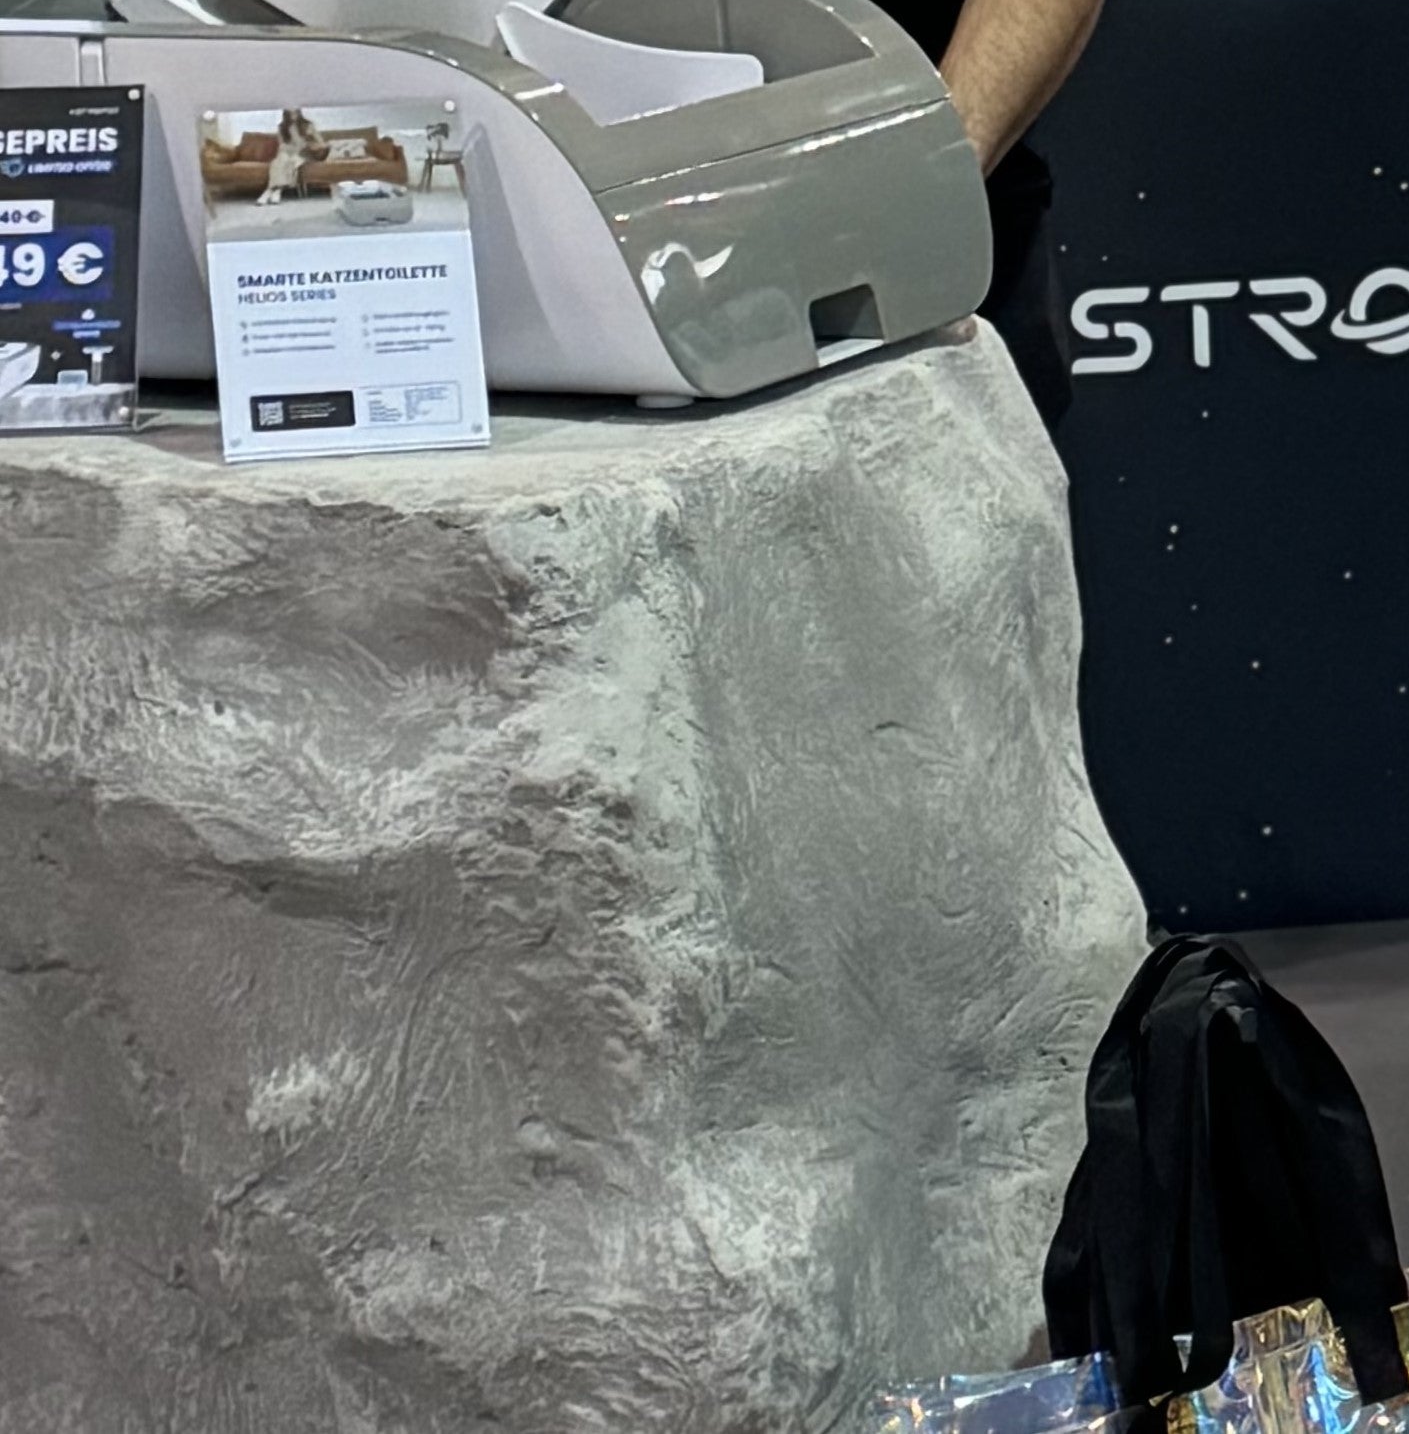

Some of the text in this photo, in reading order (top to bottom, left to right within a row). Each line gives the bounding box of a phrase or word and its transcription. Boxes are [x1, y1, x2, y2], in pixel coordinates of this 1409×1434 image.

[0, 127, 119, 155] EPREIS
[57, 242, 104, 285] €
[237, 264, 448, 288] SMARTE KATZENTOILETTE
